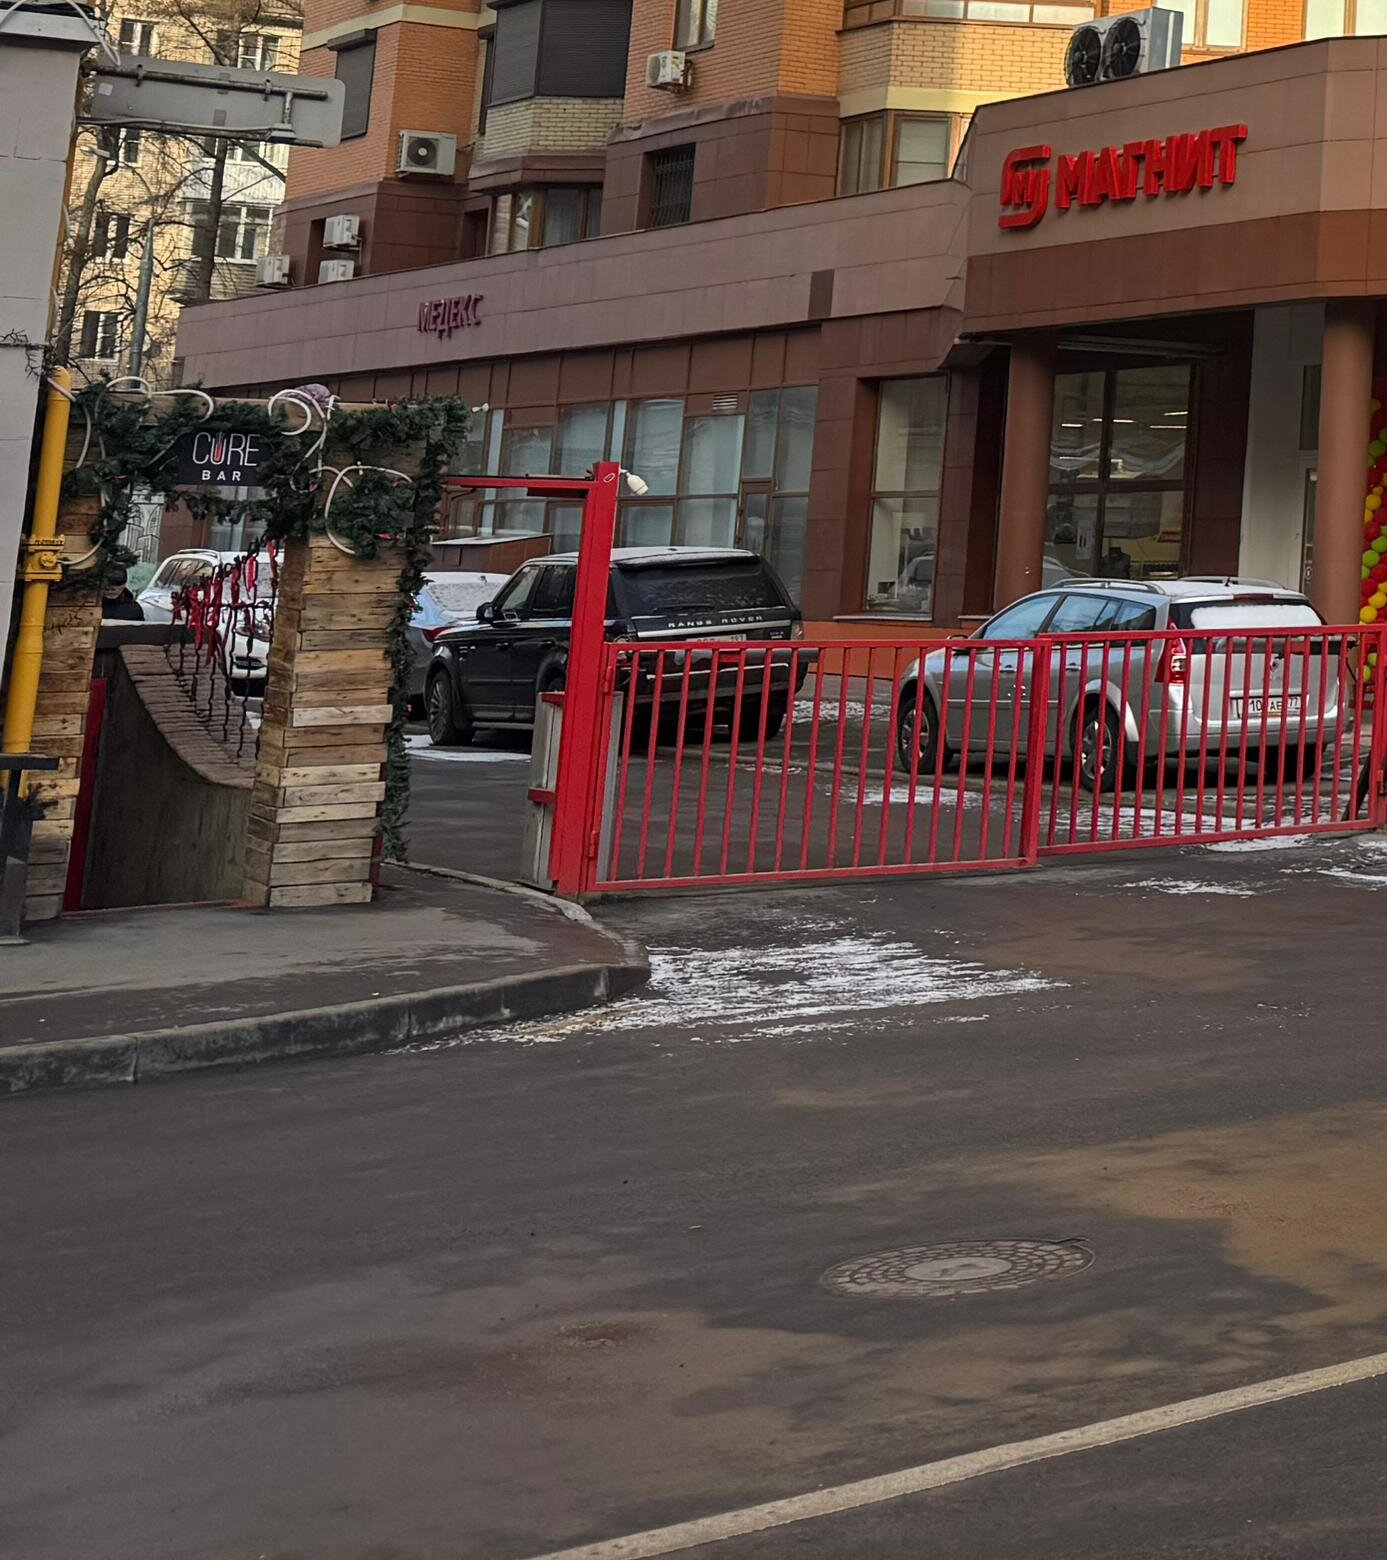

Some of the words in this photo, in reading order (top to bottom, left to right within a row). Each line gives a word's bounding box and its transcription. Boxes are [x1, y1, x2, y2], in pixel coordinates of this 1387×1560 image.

[1055, 124, 1248, 210] МАГНИТ
[418, 294, 484, 341] МЕДЕКС
[193, 432, 260, 466] CURE
[201, 470, 242, 481] BAR
[721, 615, 763, 624] ROVER
